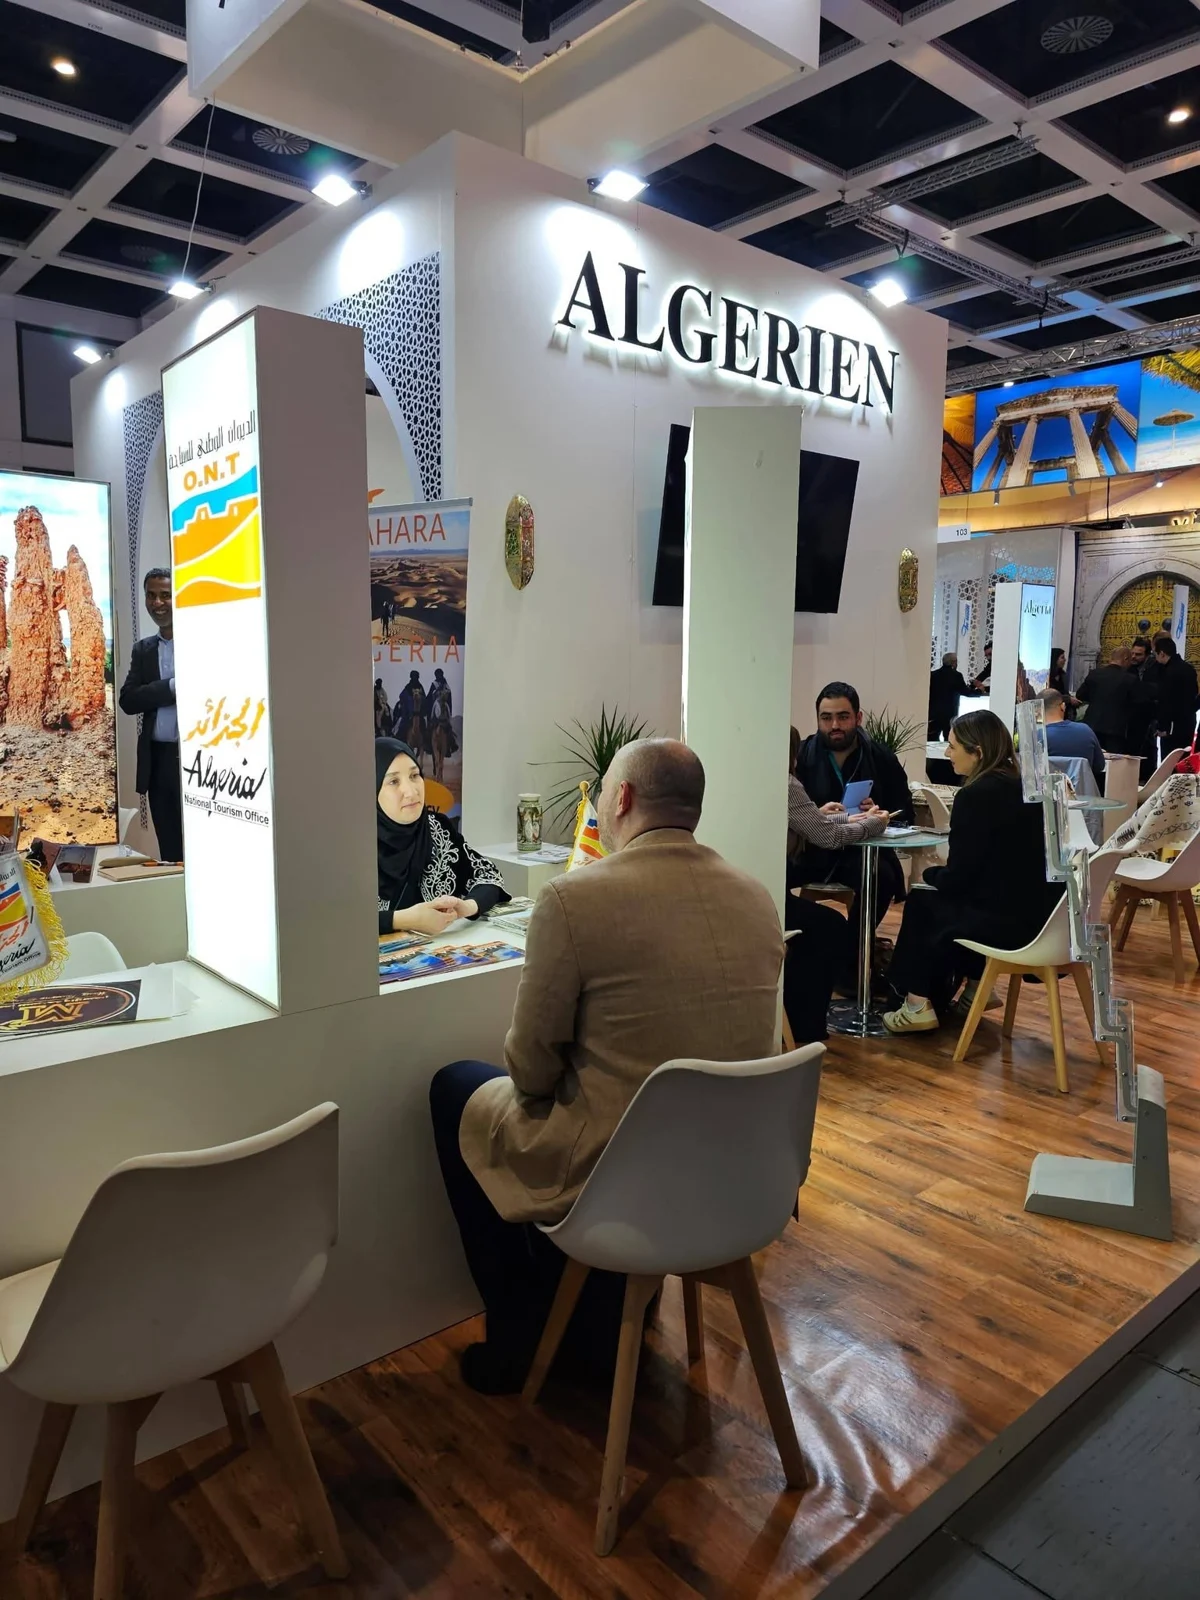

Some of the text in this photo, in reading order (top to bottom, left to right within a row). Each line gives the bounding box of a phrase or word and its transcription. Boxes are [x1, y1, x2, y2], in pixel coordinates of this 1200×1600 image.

[554, 251, 900, 413] ALGERIEN
[197, 425, 223, 459] الوطني
[228, 410, 255, 443] الديوان
[183, 451, 240, 492] O.N.T
[956, 528, 968, 536] 103
[1023, 600, 1052, 617] Algeria
[183, 696, 265, 748] الجزائر
[183, 750, 267, 817] Algeria
[184, 794, 269, 825] National Tourism Office
